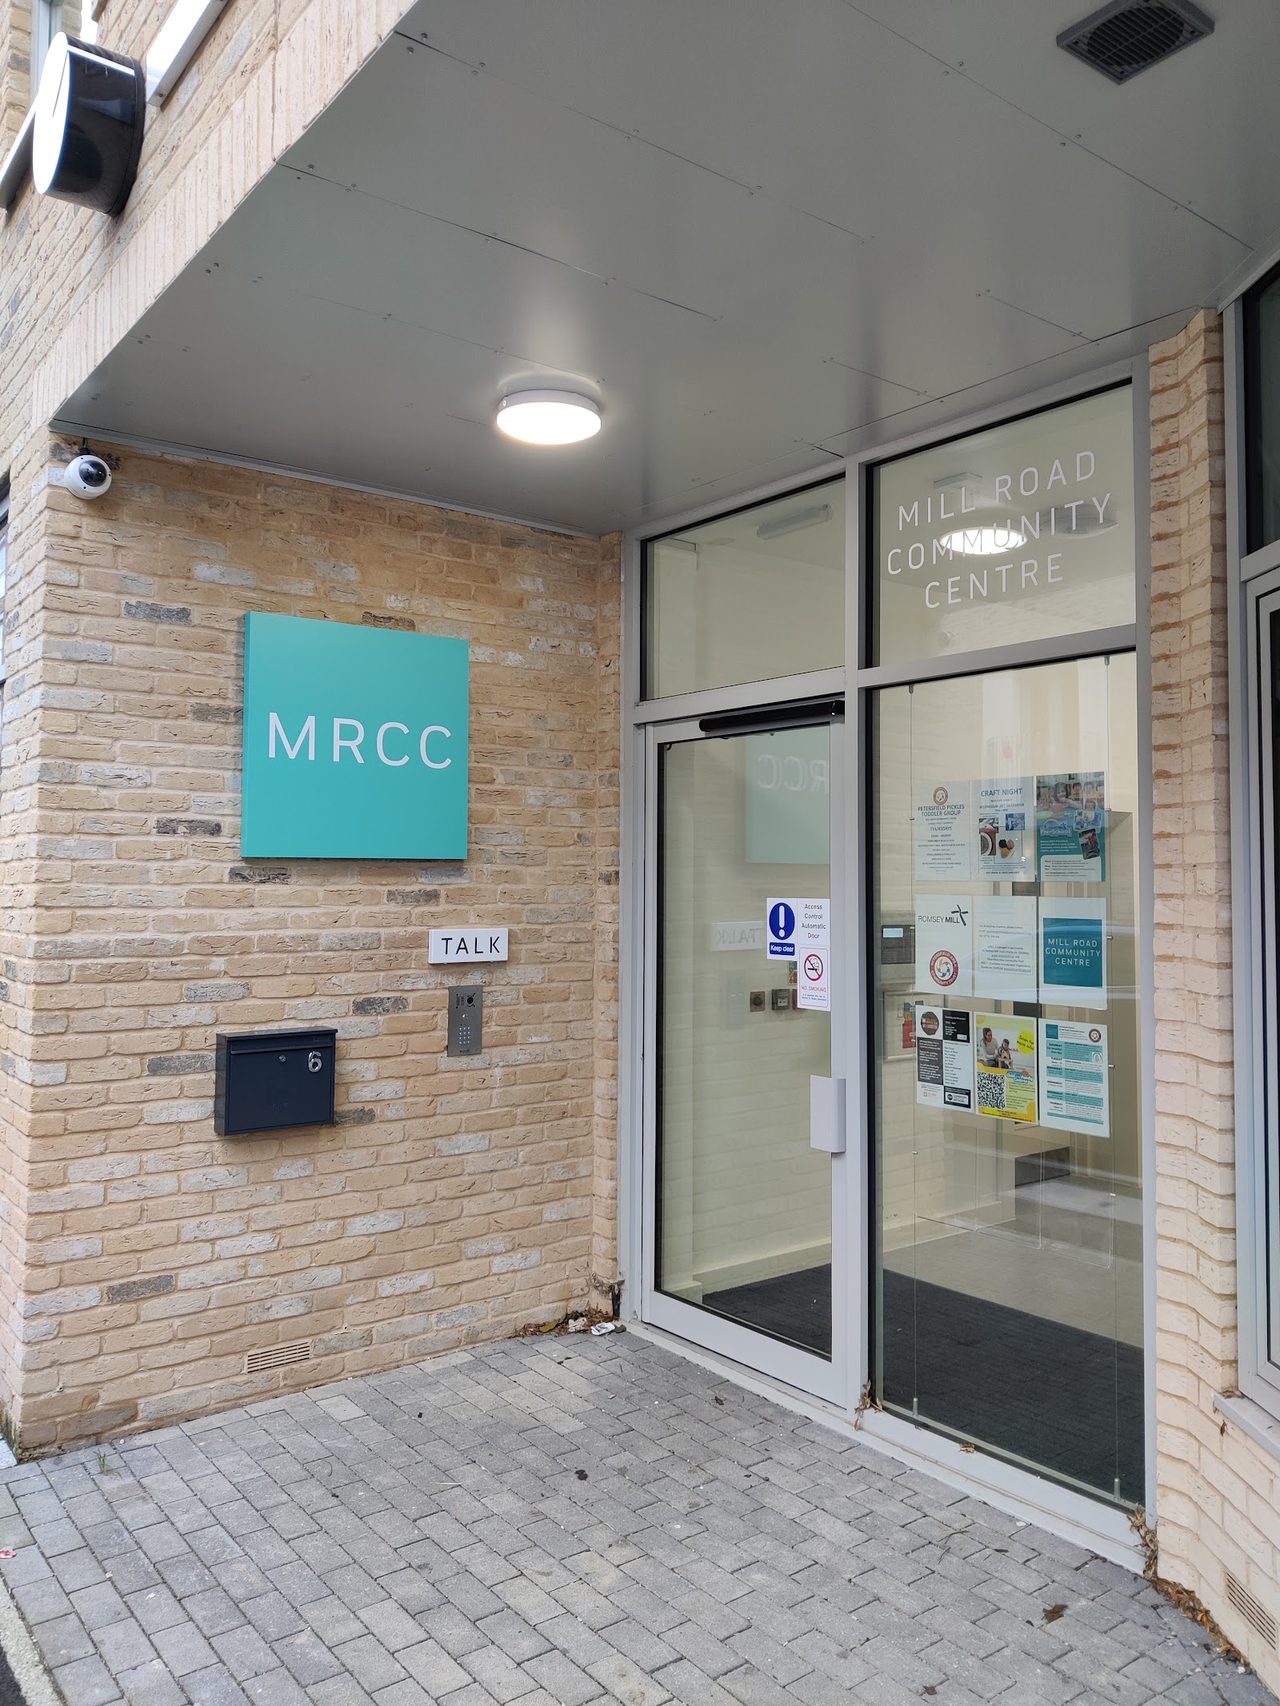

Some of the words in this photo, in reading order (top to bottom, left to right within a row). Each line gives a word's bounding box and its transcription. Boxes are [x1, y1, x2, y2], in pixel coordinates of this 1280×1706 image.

[898, 487, 977, 531] MILL
[995, 450, 1095, 503] ROAD
[887, 493, 1111, 575] COMMUNITY
[925, 553, 1064, 609] CENTRE
[268, 712, 453, 770] MRCC
[980, 789, 1000, 798] CRAFT
[1001, 788, 1023, 796] NIGHT
[918, 804, 946, 812] PETERSFIELD
[918, 915, 944, 923] ROMSEY
[945, 916, 960, 924] MILL
[801, 922, 827, 930] Automatic
[441, 936, 501, 956] TALK
[1048, 938, 1069, 946] MILL
[1073, 939, 1098, 948] ROAD
[770, 944, 782, 953] Keep
[783, 945, 794, 953] clear
[1045, 948, 1102, 958] COMMUNITY
[1055, 957, 1091, 967] CENTRE
[307, 1050, 324, 1073] 6
